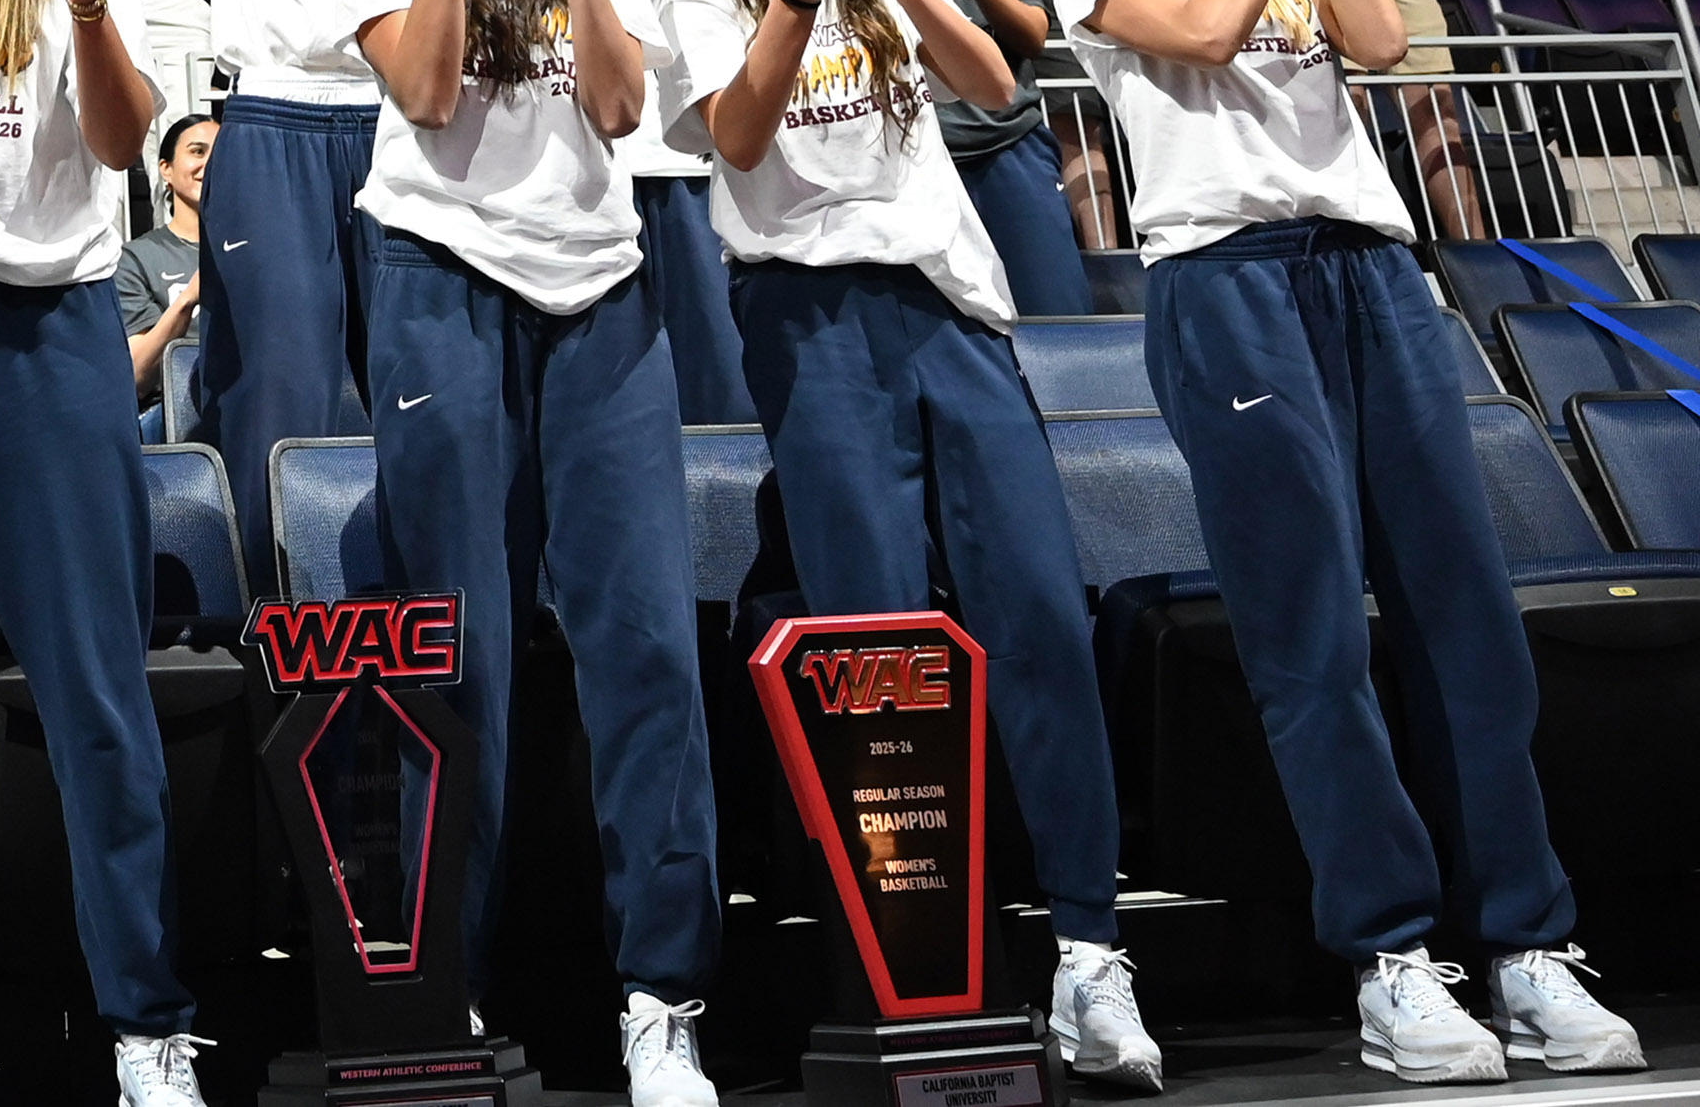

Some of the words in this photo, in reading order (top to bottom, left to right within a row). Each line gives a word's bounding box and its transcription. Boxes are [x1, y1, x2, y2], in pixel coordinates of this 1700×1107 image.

[253, 596, 457, 683] WAC
[800, 645, 952, 715] WAC
[869, 740, 913, 755] 2025-26
[852, 787, 901, 803] REGULAR
[902, 785, 946, 800] SEASON
[859, 809, 948, 834] CHAMPION
[885, 857, 937, 874] WOMEN'S
[879, 875, 948, 893] BASKETBALL
[340, 1068, 381, 1080] WESTERN
[382, 1065, 424, 1077] ATHLETIC
[425, 1061, 482, 1074] CONFERENCE
[922, 1075, 977, 1093] CALIFORNIA
[978, 1072, 1016, 1088] BAPTIST
[945, 1090, 998, 1107] UNIVERSITY
